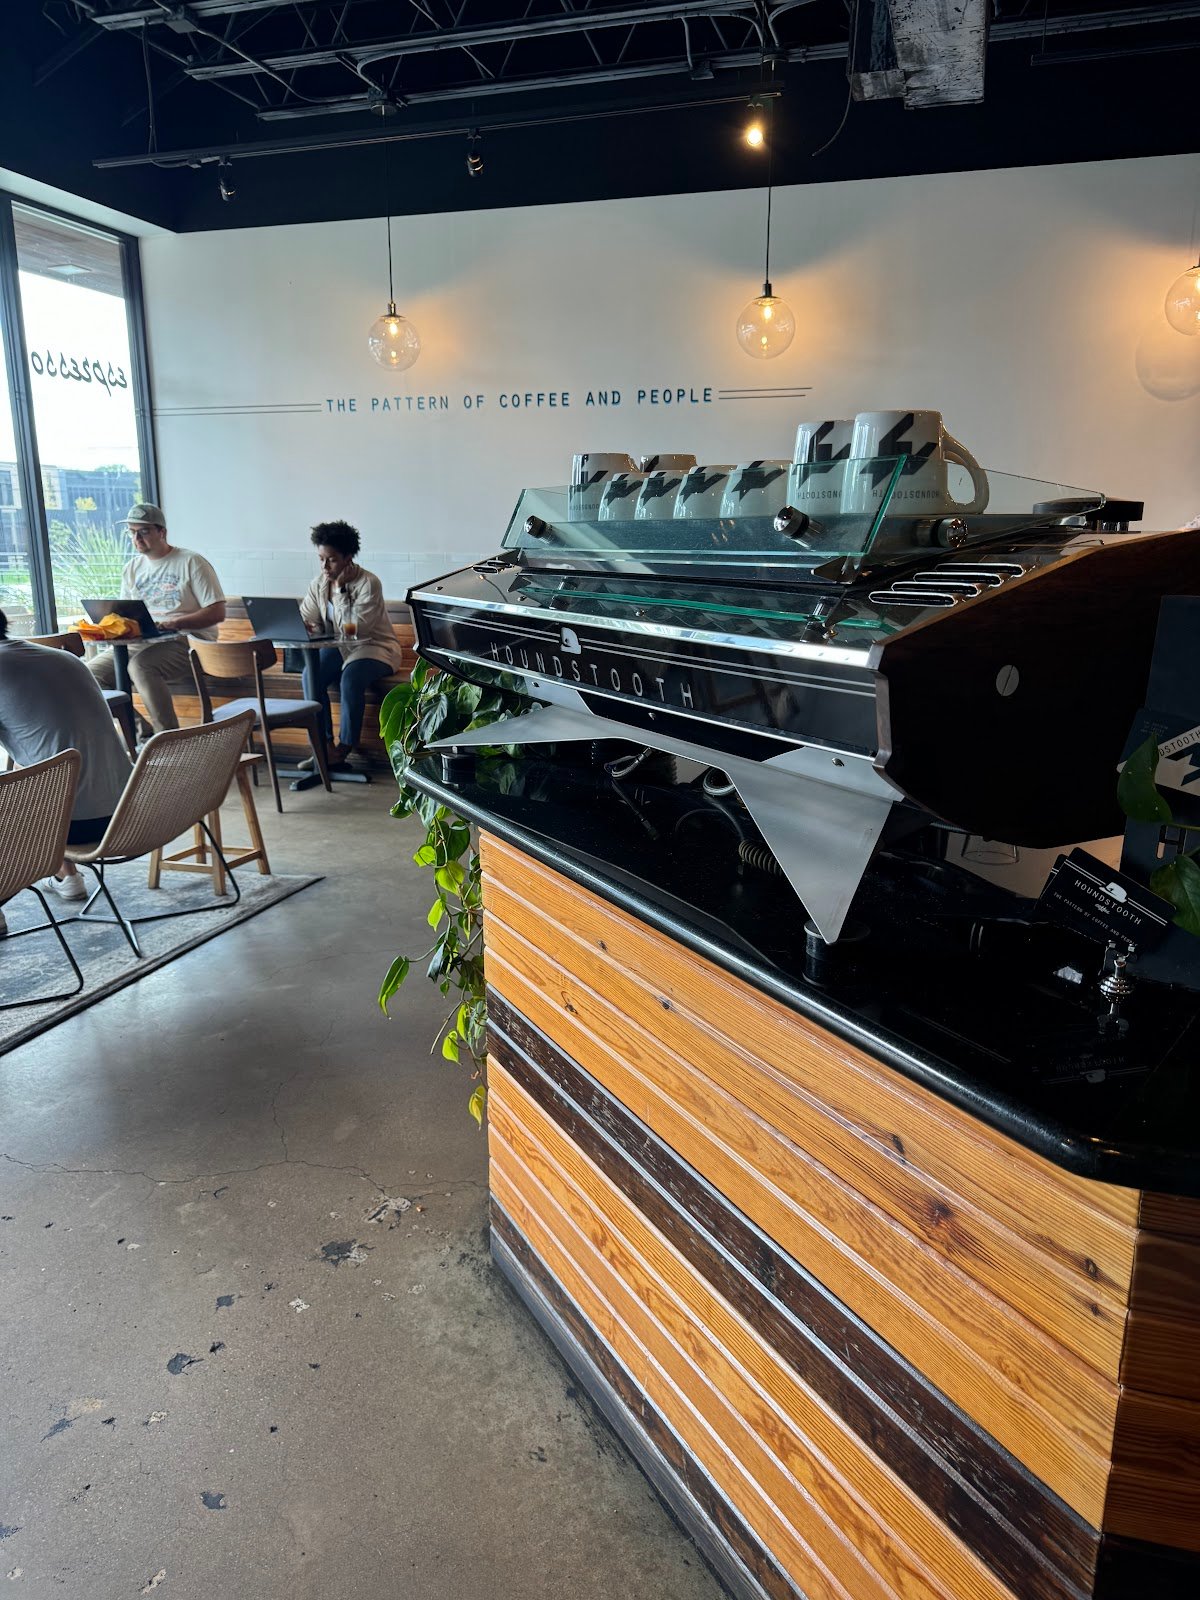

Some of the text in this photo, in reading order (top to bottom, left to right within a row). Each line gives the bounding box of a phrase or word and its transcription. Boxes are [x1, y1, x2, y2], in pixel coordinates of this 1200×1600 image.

[326, 387, 713, 412] THE PATTERN OF COFFEE AND PEOPLE
[797, 489, 842, 500] NDSTOOTH
[490, 641, 695, 709] HOUNDSTOOTH
[1159, 730, 1200, 757] DSTOOTH
[1074, 879, 1142, 925] HOUNDSTOOTH
